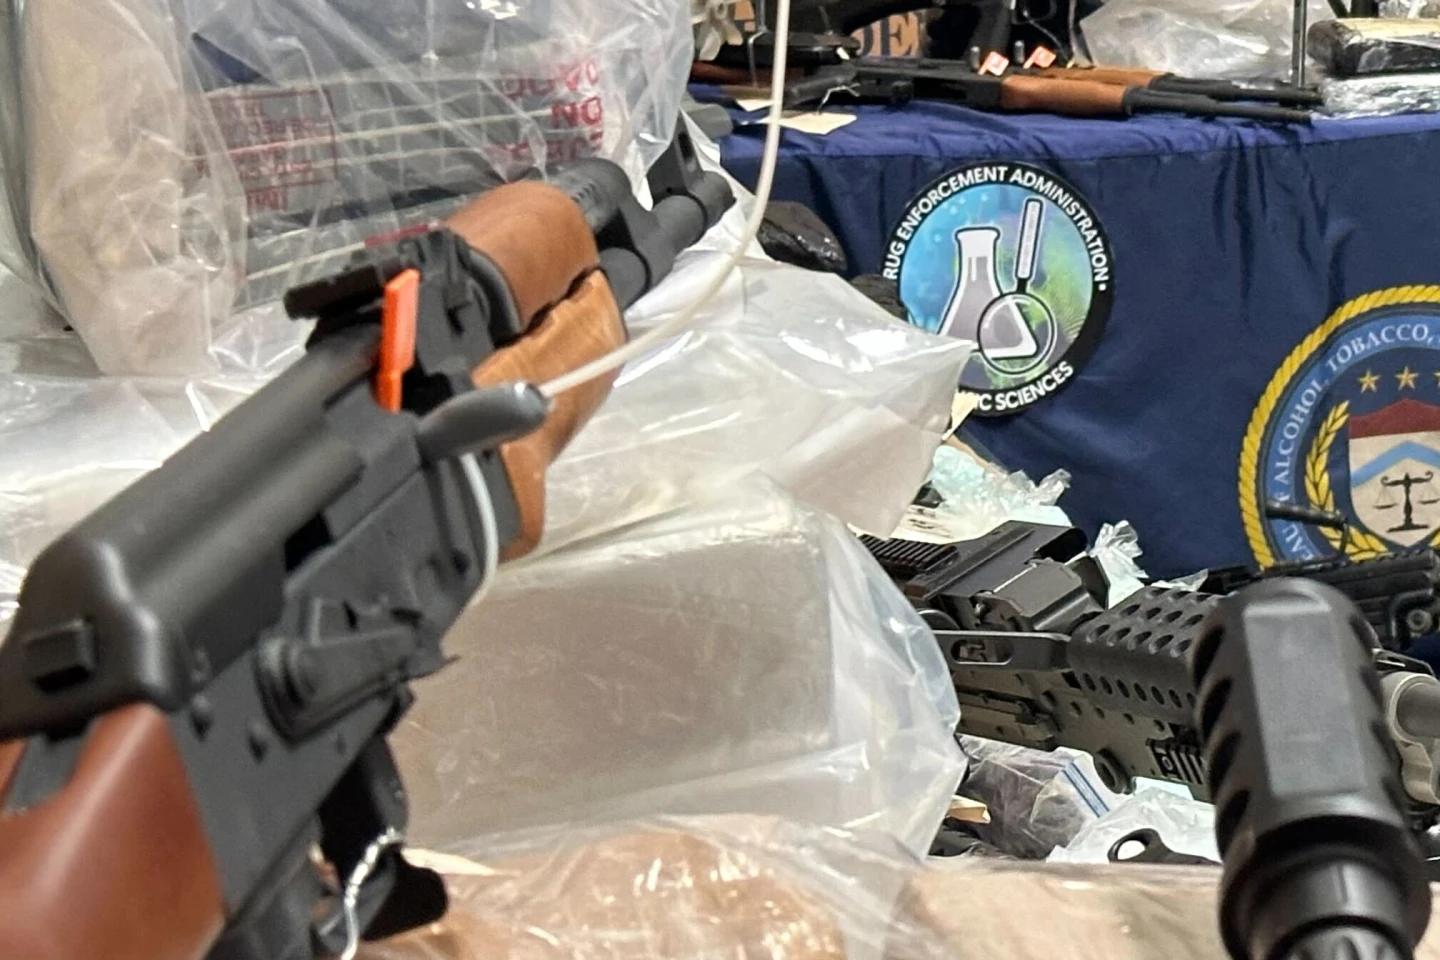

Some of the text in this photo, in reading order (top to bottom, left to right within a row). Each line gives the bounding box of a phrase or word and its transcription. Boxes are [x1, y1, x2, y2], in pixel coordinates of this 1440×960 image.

[882, 166, 1110, 283] RUG ENFORCEMENT ADMINISTRATION
[995, 360, 1074, 412] SCIENCES
